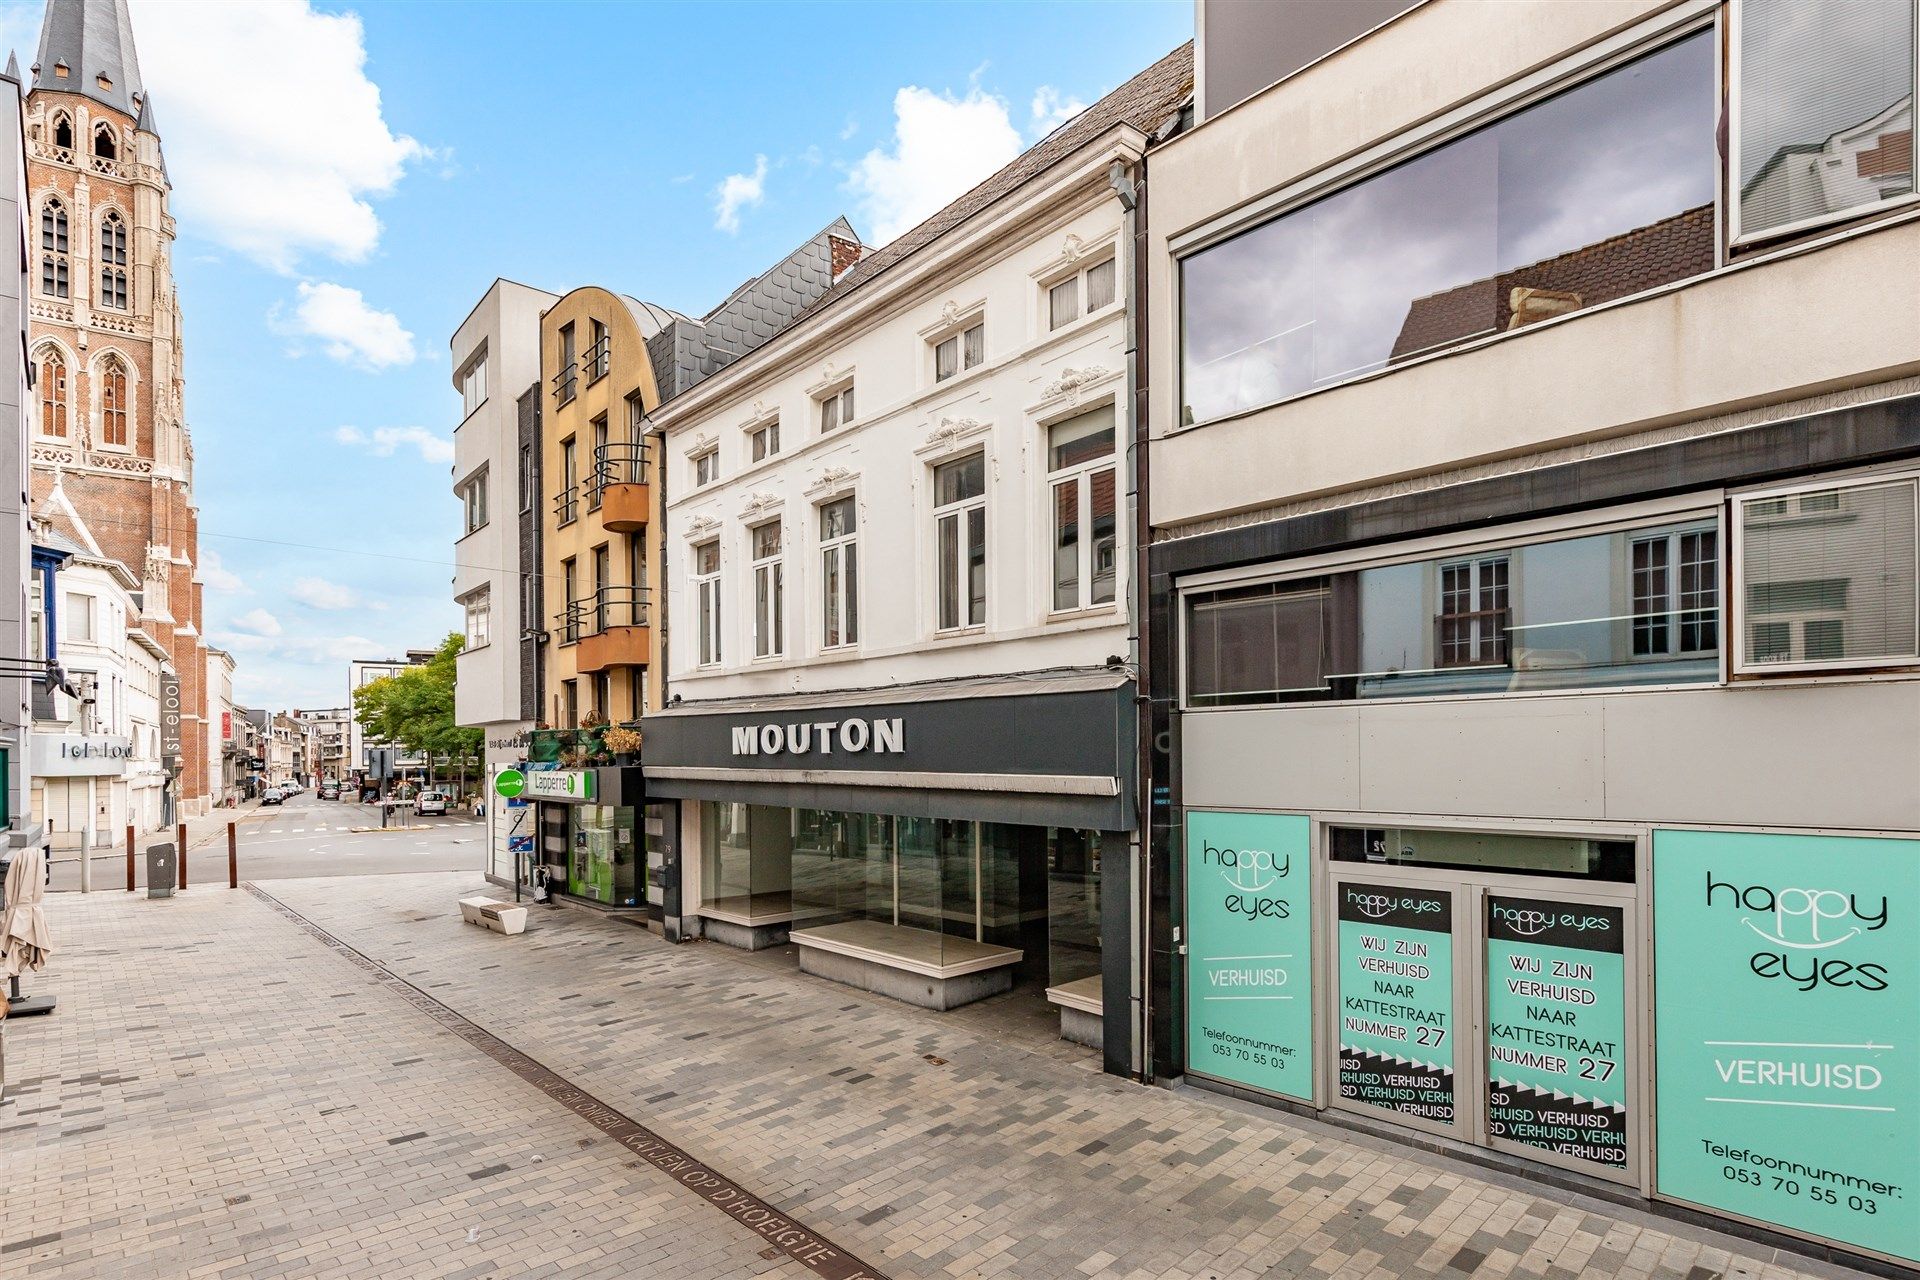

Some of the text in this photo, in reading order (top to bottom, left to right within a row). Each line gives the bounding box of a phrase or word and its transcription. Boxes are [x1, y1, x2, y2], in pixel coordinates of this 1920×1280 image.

[162, 680, 180, 751] st-elooi
[731, 717, 904, 755] MOUTON
[534, 773, 567, 794] Lapperre
[1203, 839, 1289, 886] happy
[1225, 894, 1290, 921] eyes
[1347, 888, 1442, 915] happy eyes
[1706, 870, 1888, 942] happy
[1493, 902, 1610, 932] happy eyes
[1360, 935, 1428, 958] WIJ ZIJN
[1208, 968, 1288, 987] VERHUISD
[1358, 956, 1430, 980] VERHUISD
[1509, 955, 1592, 981] WIJ ZIJN
[1749, 952, 1889, 992] eyes
[1374, 980, 1415, 999] NAAR
[1507, 978, 1596, 1005] VERHUISD
[1345, 996, 1446, 1026] KATTESTRAAT
[1526, 1005, 1576, 1027] NAAR
[1202, 1026, 1297, 1058] Telefoonnummer:
[1345, 1017, 1446, 1048] NUMMER 27
[1491, 1023, 1616, 1058] KATTESTRAAT
[1212, 1043, 1285, 1070] 053 70 55 03
[1491, 1045, 1616, 1082] NUMMER 27
[1341, 1071, 1441, 1089] RHUISD VERHUISD
[1714, 1058, 1883, 1090] VERHUISD
[1360, 1086, 1415, 1101] VERHUISD
[1395, 1102, 1453, 1119] VERHUISD
[1537, 1110, 1609, 1128] VERHUISD
[1508, 1123, 1578, 1141] VERHUISD
[1552, 1142, 1626, 1162] VERHUISD
[1701, 1138, 1903, 1199] Telefoonnummer:
[621, 1131, 838, 1266] KATJEN OP D'HOEIGTE
[1723, 1165, 1877, 1215] 053 70 55 03
